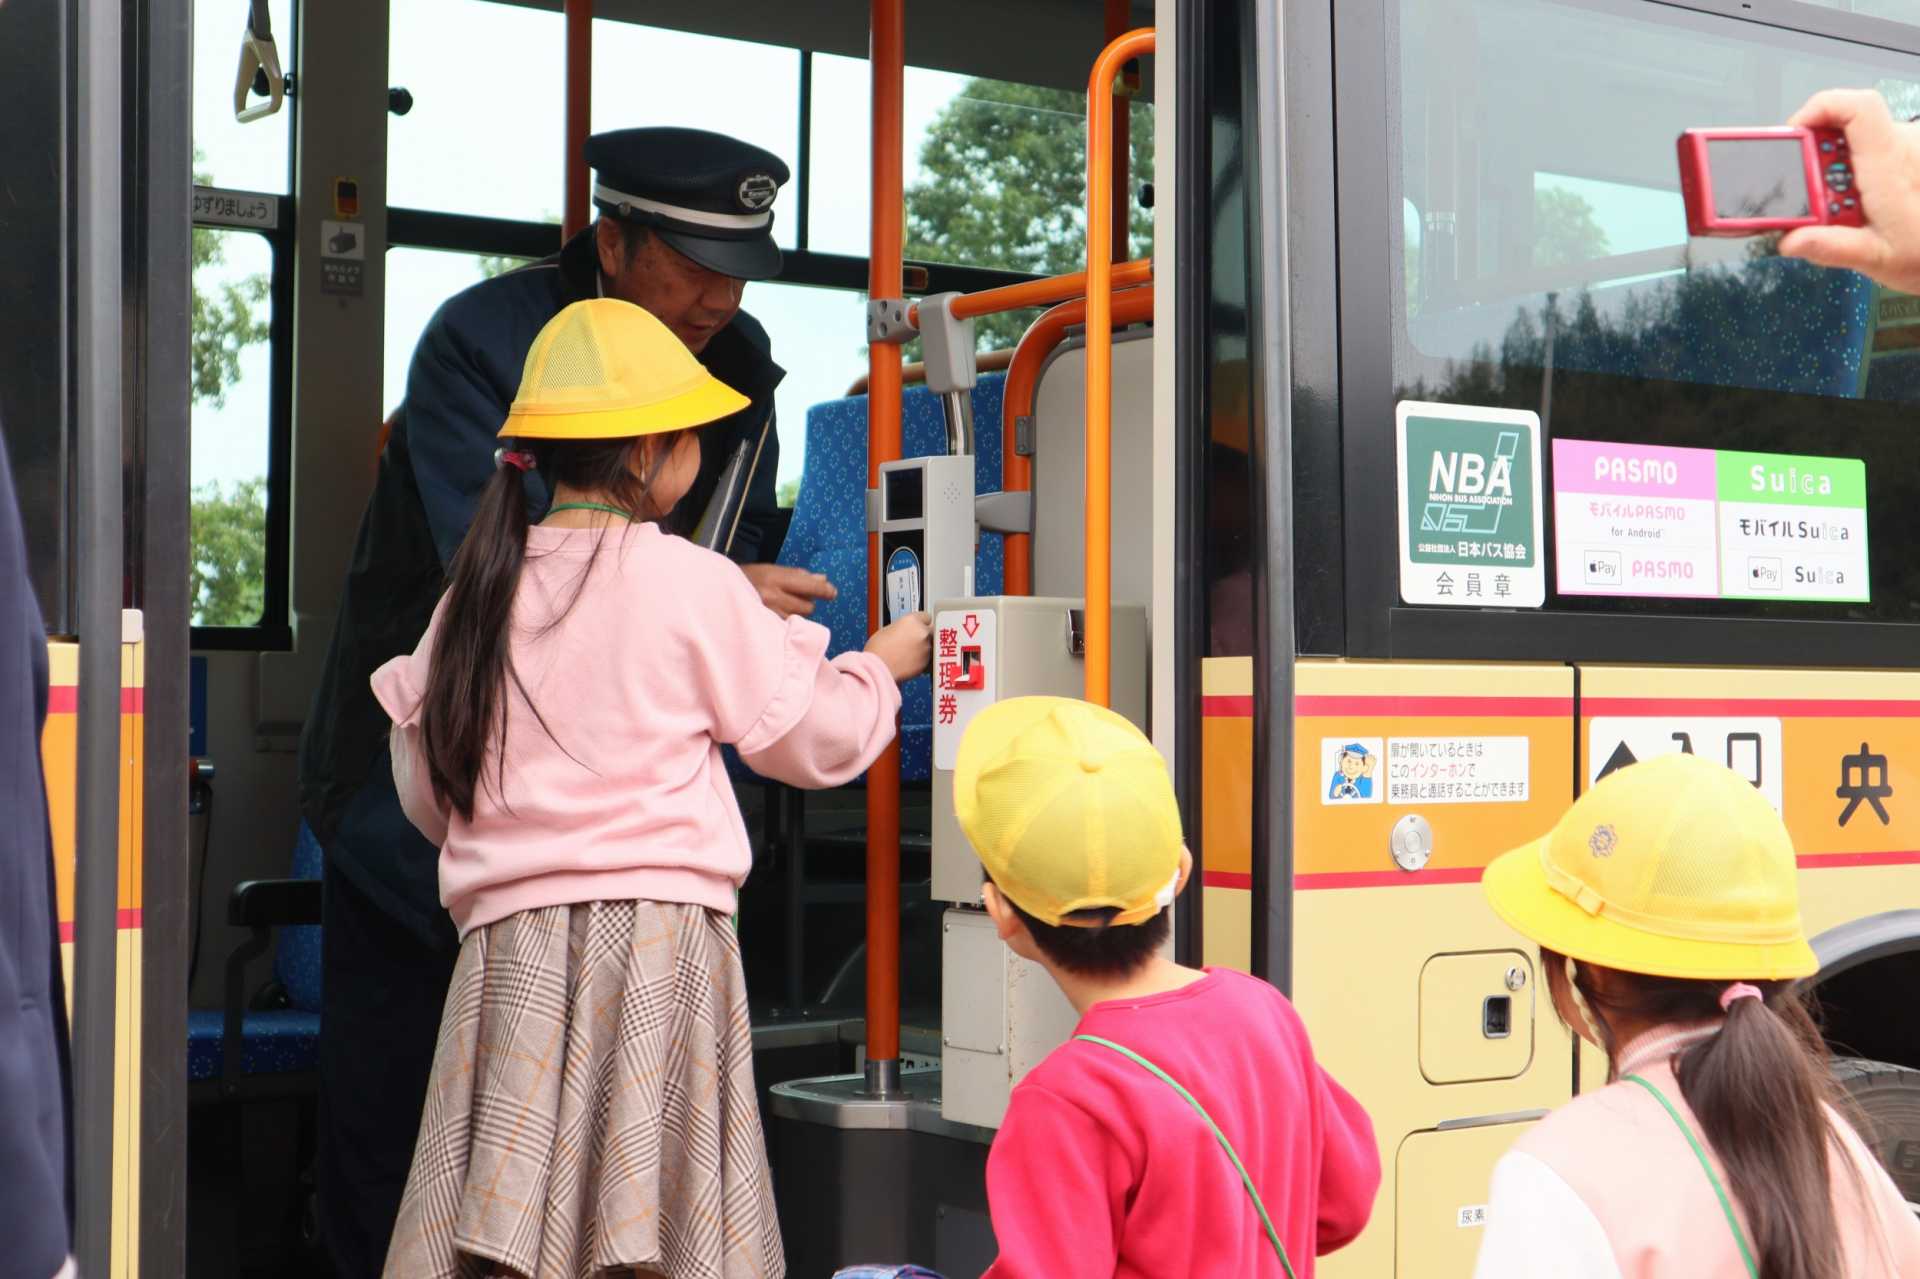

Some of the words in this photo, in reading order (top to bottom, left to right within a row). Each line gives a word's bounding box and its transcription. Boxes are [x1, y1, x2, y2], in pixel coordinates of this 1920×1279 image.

[1429, 450, 1513, 497] NBA
[1594, 456, 1678, 485] PASMO
[1751, 464, 1832, 495] Suica
[1428, 493, 1453, 502] NIHON
[1454, 494, 1468, 504] BUS
[1469, 495, 1513, 506] ASSOCIATION
[1589, 502, 1686, 520] モバイルPASMO
[1611, 526, 1623, 537] for
[1458, 541, 1527, 560] 日本バス協会
[1598, 560, 1617, 577] Pay
[1632, 560, 1694, 579] PASMO
[1795, 566, 1844, 584] Suica
[1436, 571, 1512, 598] 会員章
[939, 628, 958, 724] 整理券
[1391, 742, 1483, 758] 扉が開いているときは
[1391, 762, 1477, 779] このインターホンで
[1836, 741, 1893, 828] 央
